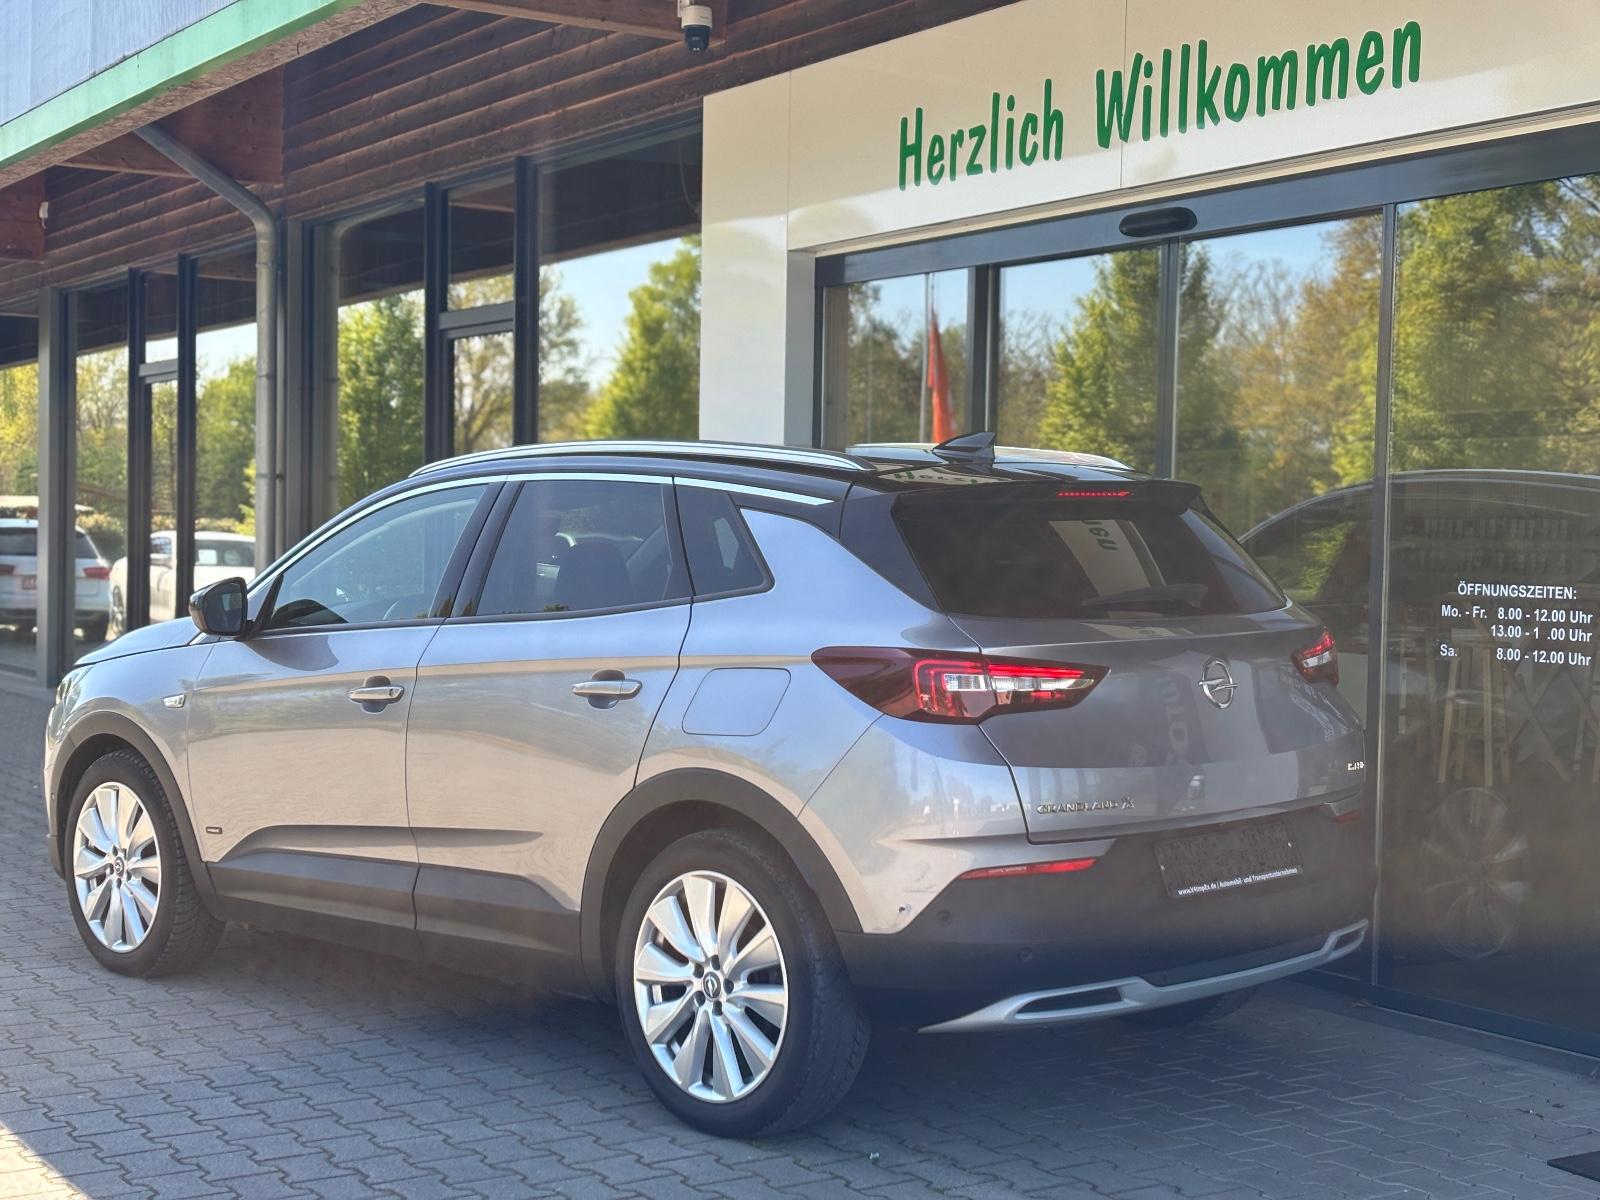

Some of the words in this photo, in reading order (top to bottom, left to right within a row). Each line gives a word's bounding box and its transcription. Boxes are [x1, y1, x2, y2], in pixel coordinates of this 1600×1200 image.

[899, 79, 1064, 190] Herzlich
[1097, 21, 1421, 149] Willkommen
[1457, 580, 1577, 600] ÖFFNUNGSZEITEN:
[1441, 604, 1462, 618] Mo.
[1472, 605, 1488, 619] Fr.
[1497, 606, 1523, 621] 8.00
[1533, 608, 1566, 623] 12.00
[1569, 610, 1594, 624] Uhr
[1490, 624, 1522, 638] 13.00
[1569, 628, 1593, 643] Uhr
[1439, 643, 1458, 657] Sa.
[1496, 647, 1521, 662] 8.00
[1532, 649, 1565, 665] 12.00
[1568, 651, 1592, 667] Uhr
[1036, 799, 1119, 814] GRANDLAND
